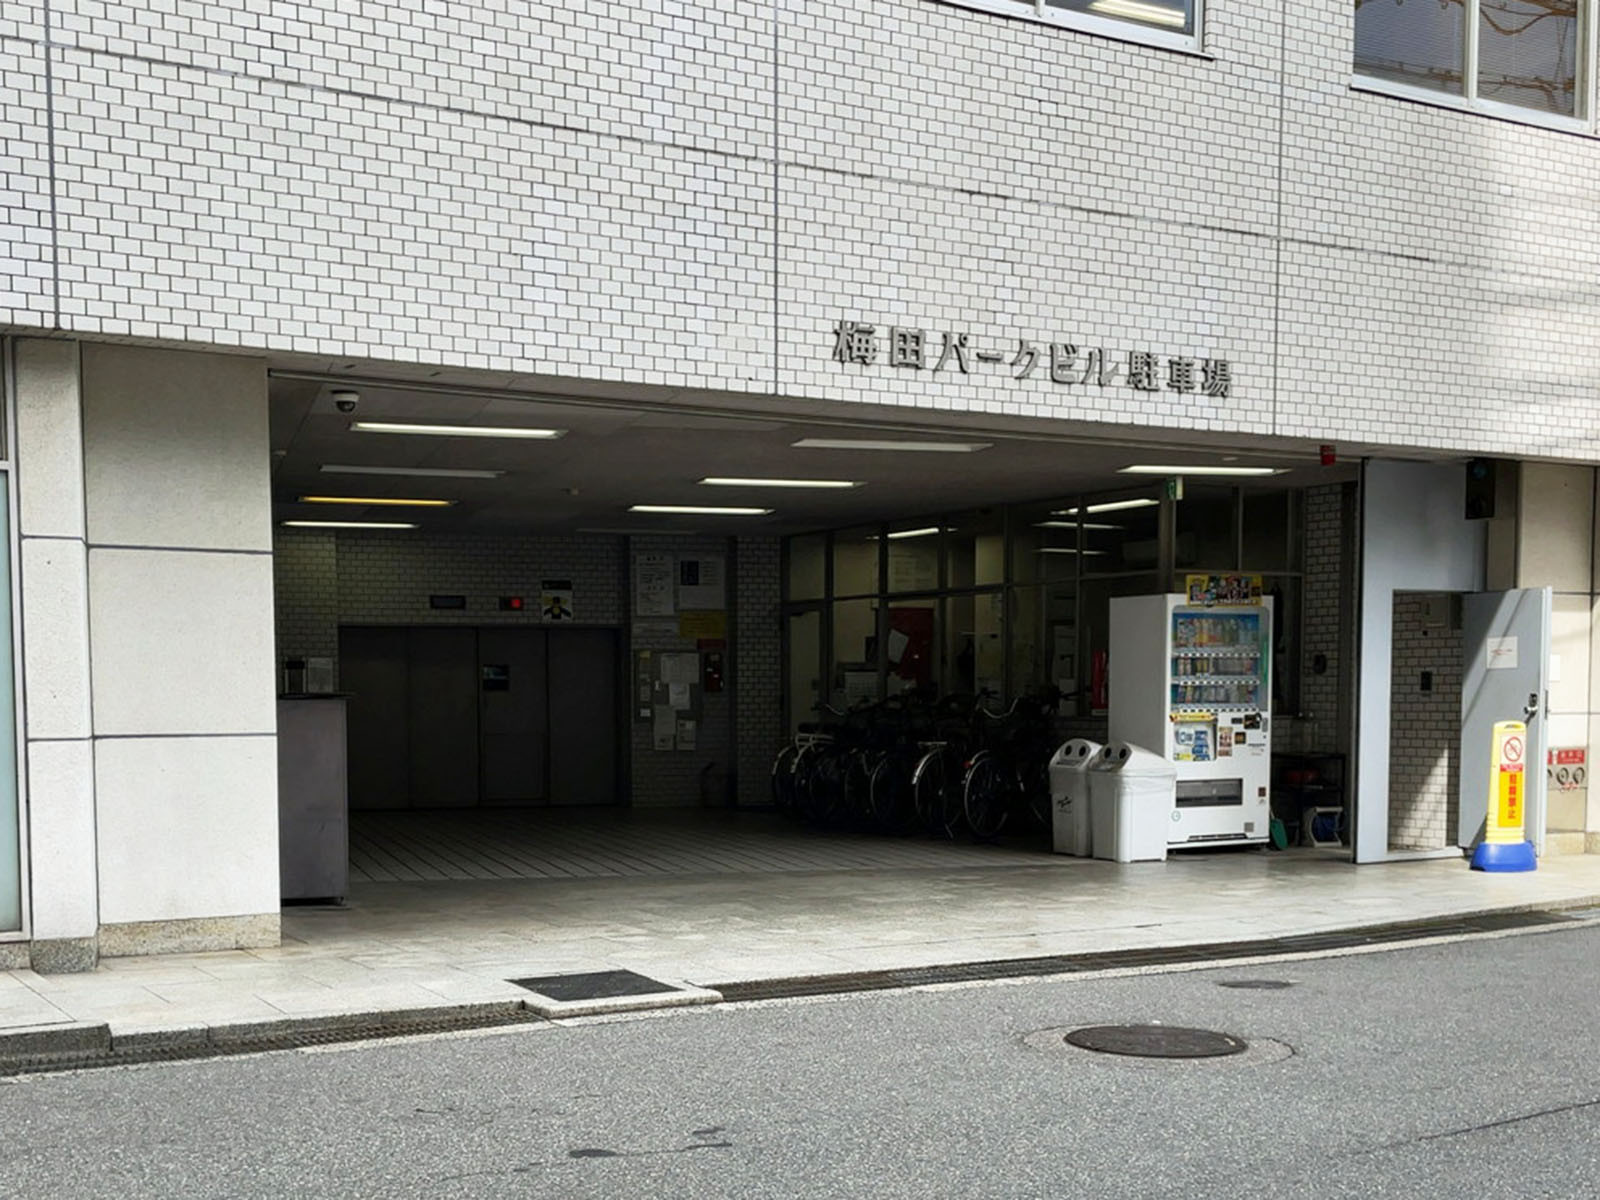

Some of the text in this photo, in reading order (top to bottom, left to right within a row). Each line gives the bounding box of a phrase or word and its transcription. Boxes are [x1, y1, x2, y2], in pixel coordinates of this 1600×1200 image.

[832, 320, 1232, 398] 梅田パークビル駐車場
